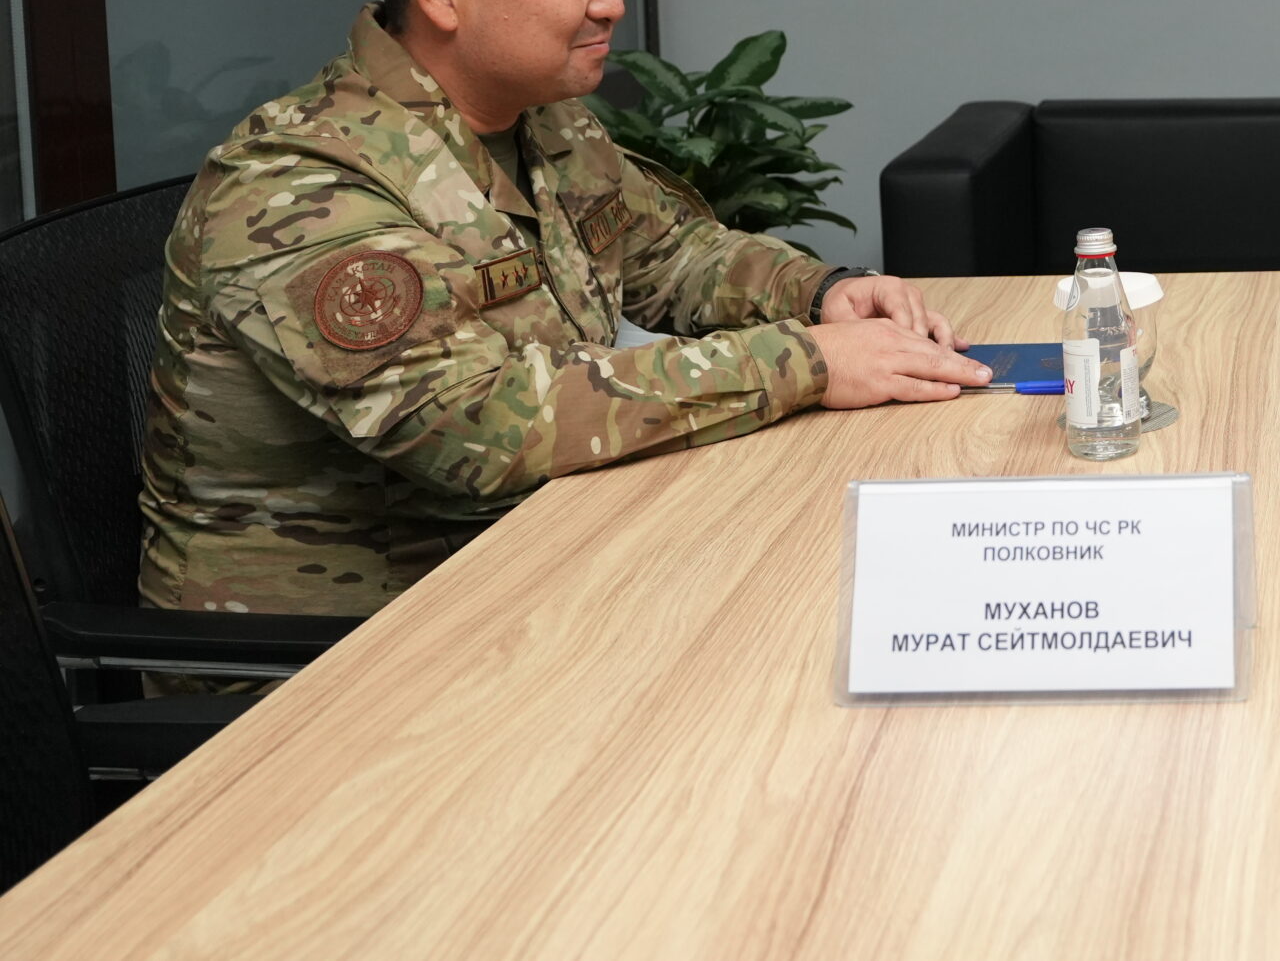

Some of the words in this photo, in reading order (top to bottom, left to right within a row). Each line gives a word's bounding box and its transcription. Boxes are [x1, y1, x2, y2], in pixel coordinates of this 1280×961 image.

[951, 521, 1046, 538] МИНИСТР
[1052, 521, 1079, 536] ПО
[1085, 520, 1111, 535] ЧС
[1118, 520, 1142, 535] РК
[983, 545, 1104, 561] ПОЛКОВНИК
[984, 601, 1100, 620] МУХАНОВ
[892, 633, 971, 653] МУРАТ
[977, 627, 1193, 653] СЕЙТМОЛДАЕВИЧ
